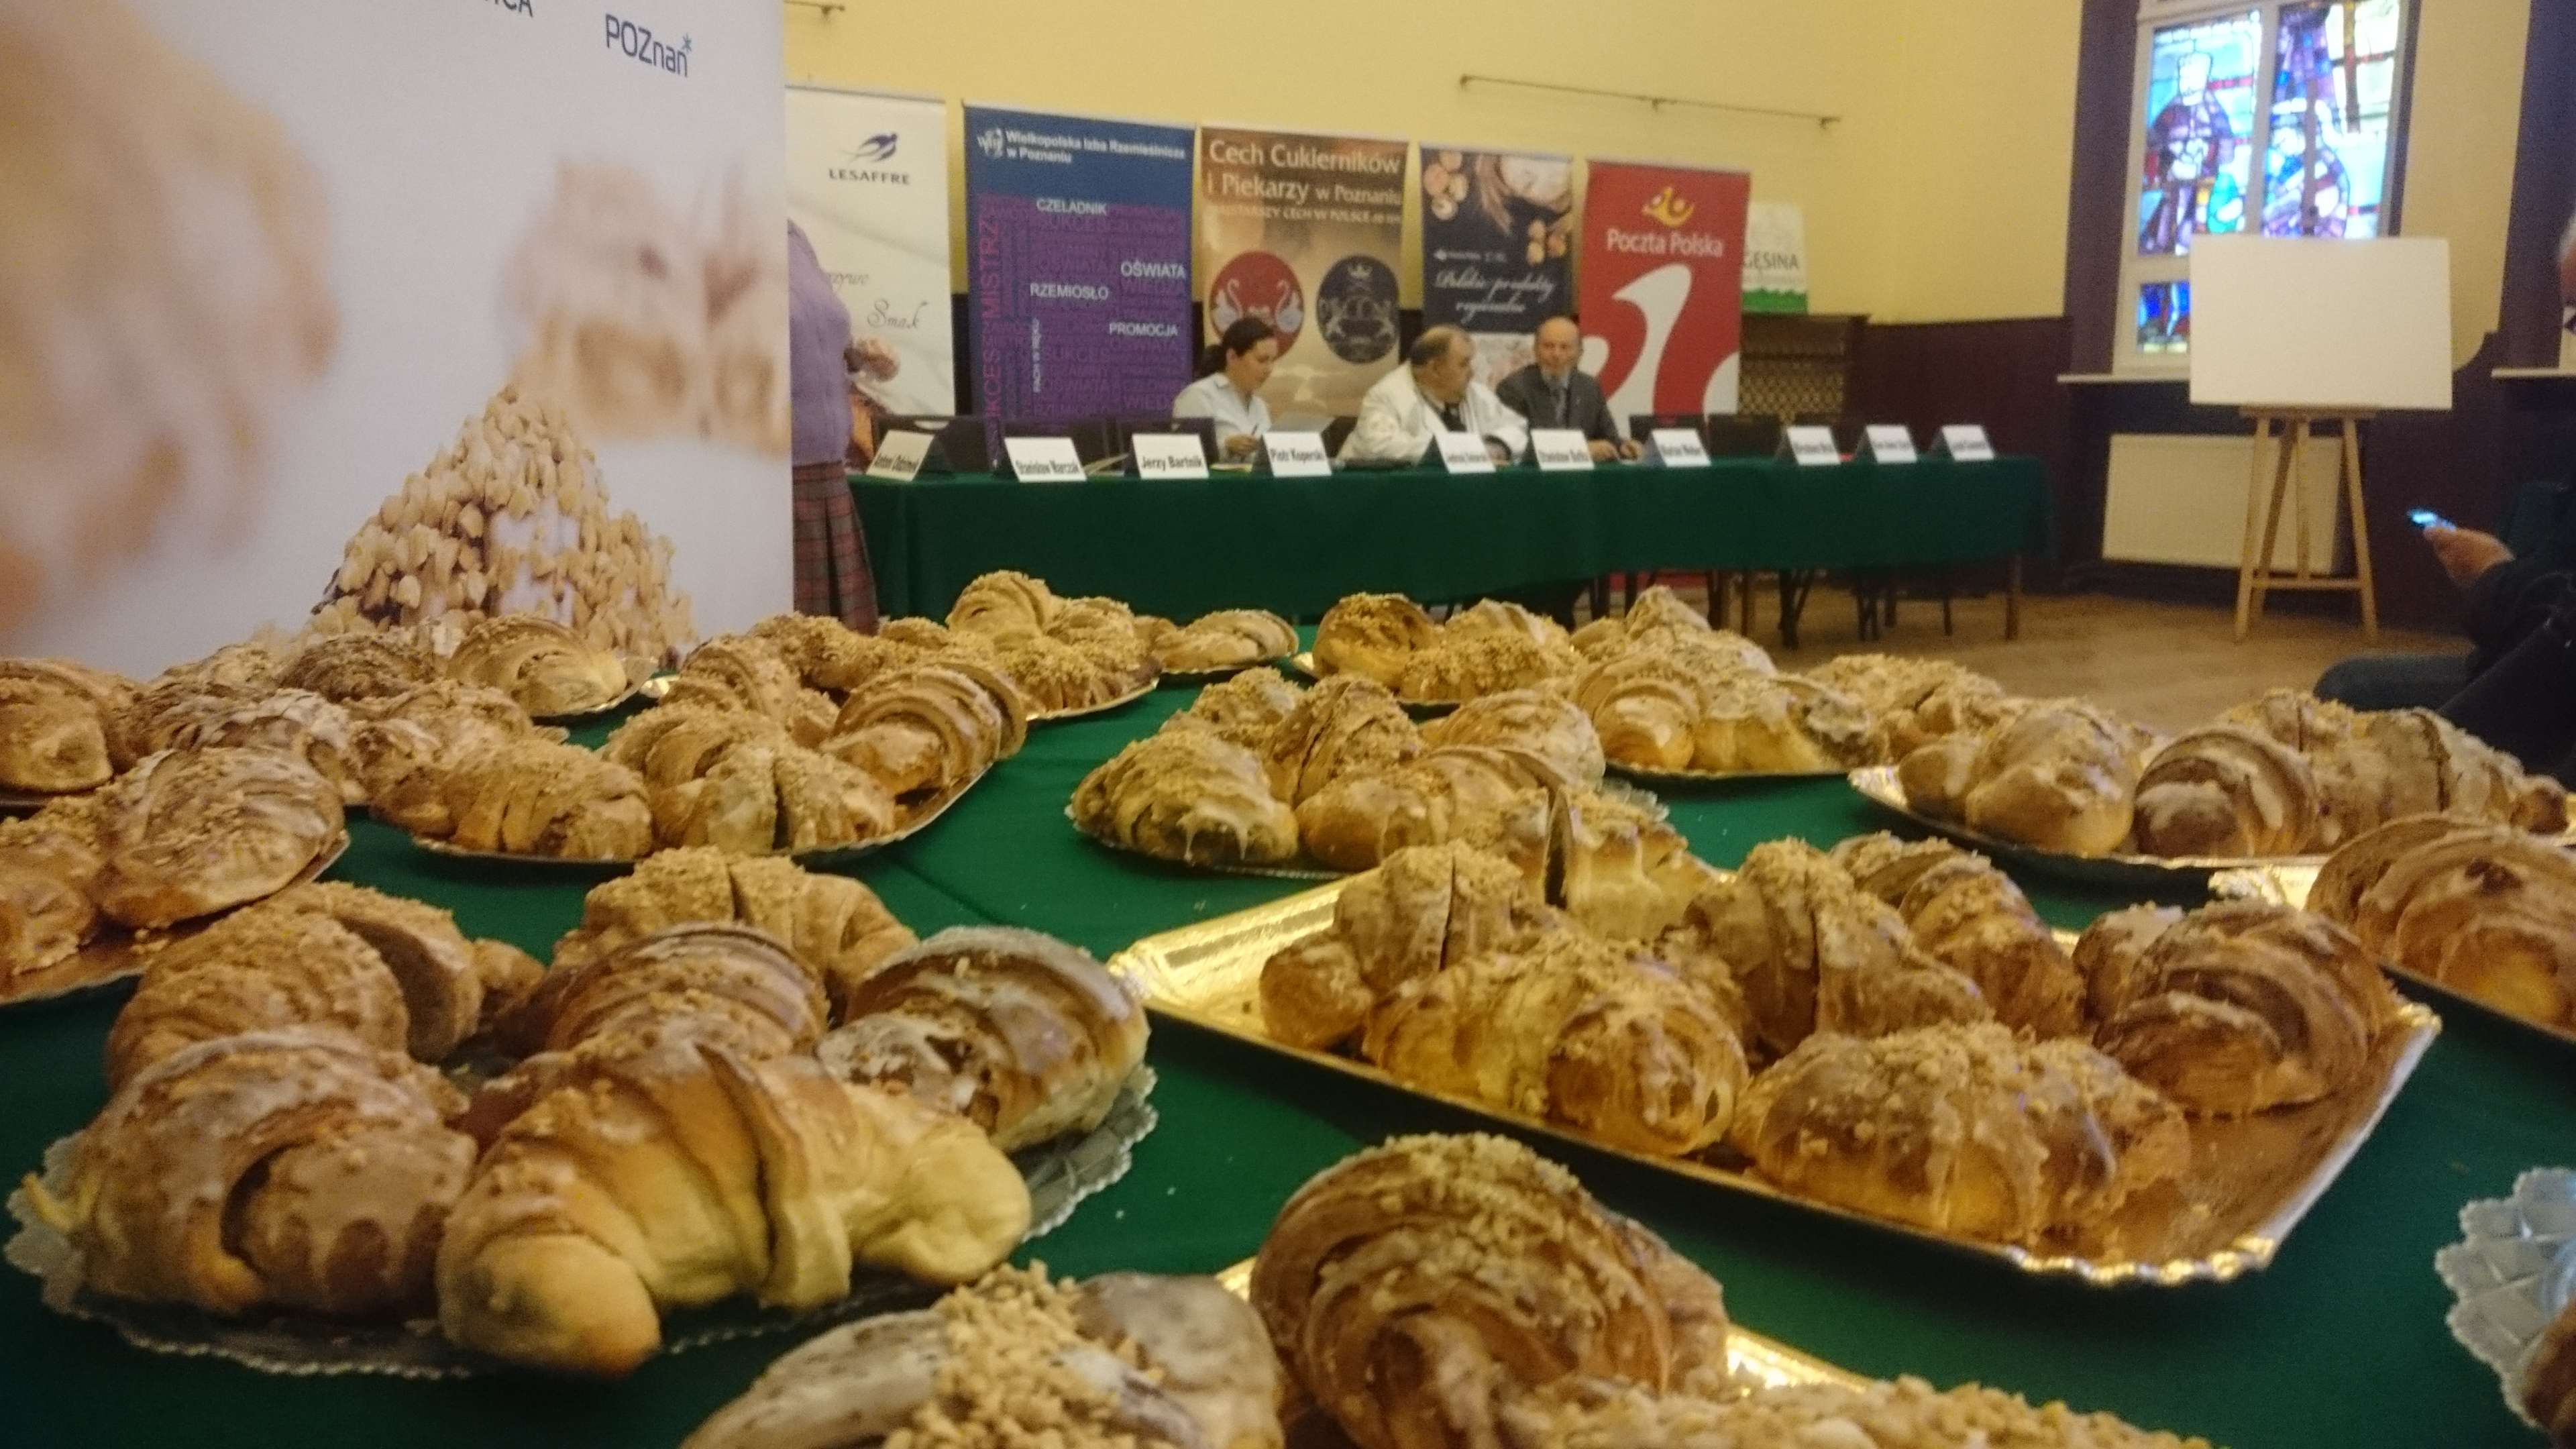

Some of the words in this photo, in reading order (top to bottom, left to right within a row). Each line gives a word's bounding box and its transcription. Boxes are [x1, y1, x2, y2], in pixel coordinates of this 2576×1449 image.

[1006, 130, 1081, 150] Wielkopolska
[1007, 148, 1016, 158] w
[1019, 147, 1072, 163] Poznaniu
[1210, 140, 1264, 165] Cech
[1271, 144, 1401, 174] Cukierników
[829, 168, 910, 186] LESAFFRE
[1222, 173, 1309, 205] Piekarzy
[1316, 187, 1331, 201] w
[1036, 199, 1108, 215] CZELADNIK
[1606, 227, 1666, 254] Poczta
[1669, 230, 1723, 258] Polska
[1121, 260, 1186, 279] OŚWIATA
[1030, 282, 1109, 301] RZEMIOSŁO
[867, 298, 929, 329] Smak
[1109, 322, 1179, 337] PROMOCJA
[1142, 455, 1166, 472] Jerzy
